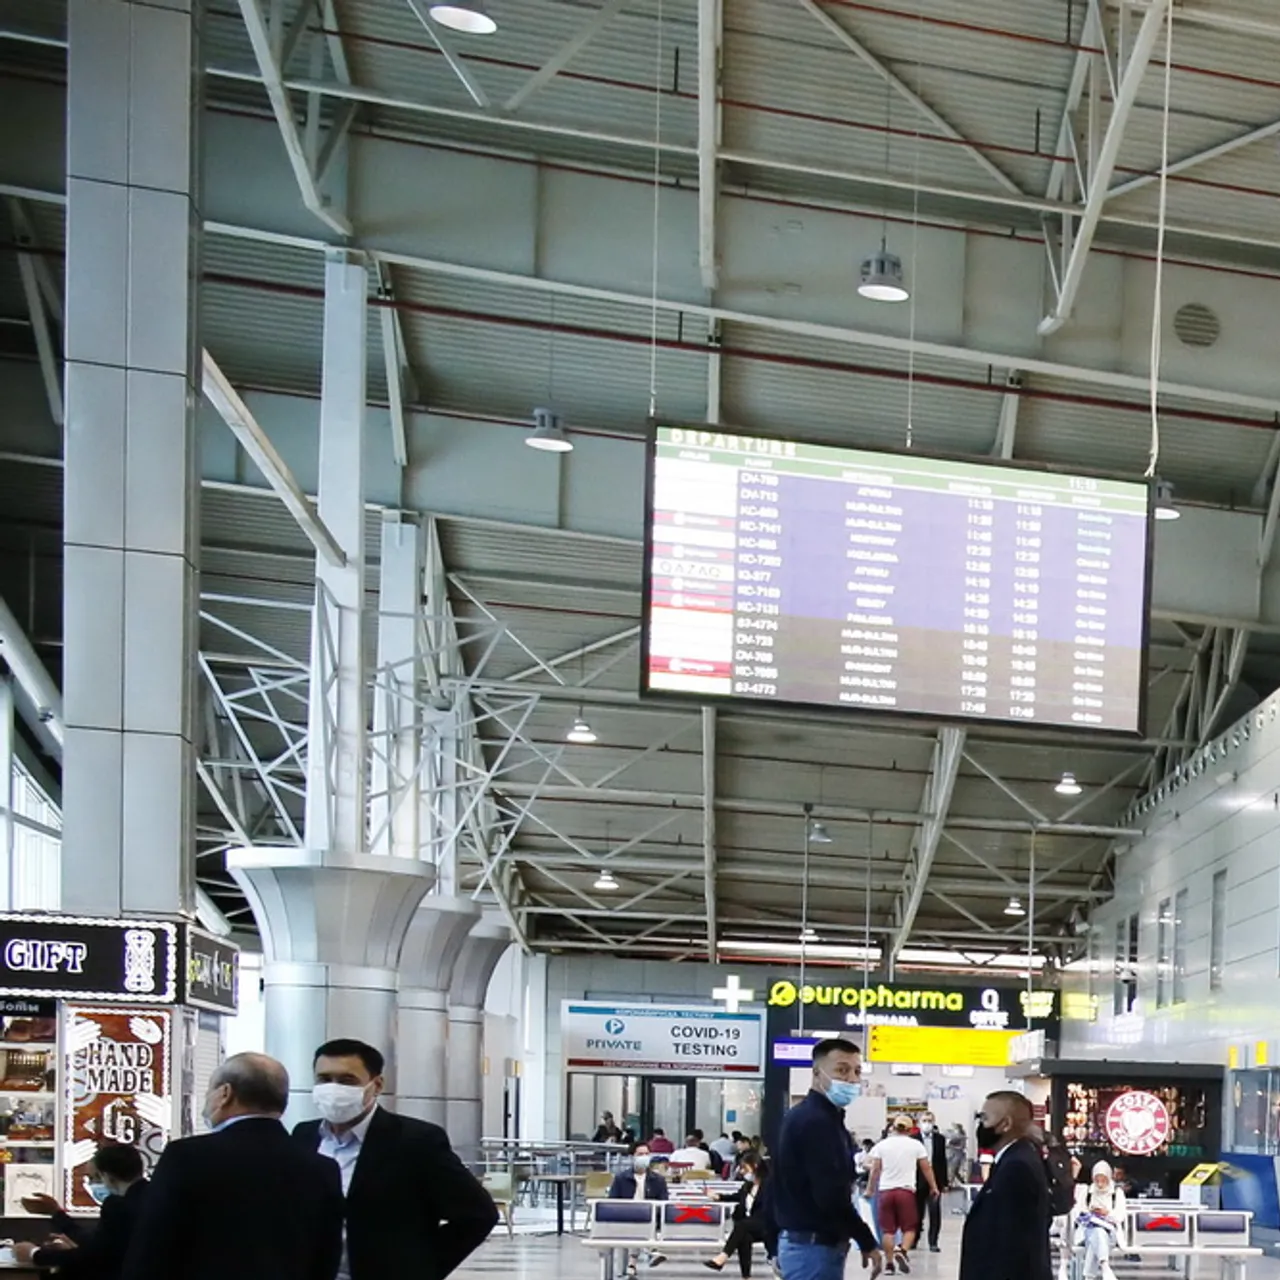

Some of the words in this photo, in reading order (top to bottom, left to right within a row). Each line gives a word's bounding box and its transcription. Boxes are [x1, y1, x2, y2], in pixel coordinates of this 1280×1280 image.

[671, 429, 797, 456] DEPARTURE
[5, 938, 87, 974] GIFT
[798, 984, 965, 1013] europharma
[670, 1024, 741, 1041] COVID-19
[87, 1042, 154, 1070] HAND
[673, 1042, 739, 1057] TESTING
[86, 1067, 154, 1094] MADE
